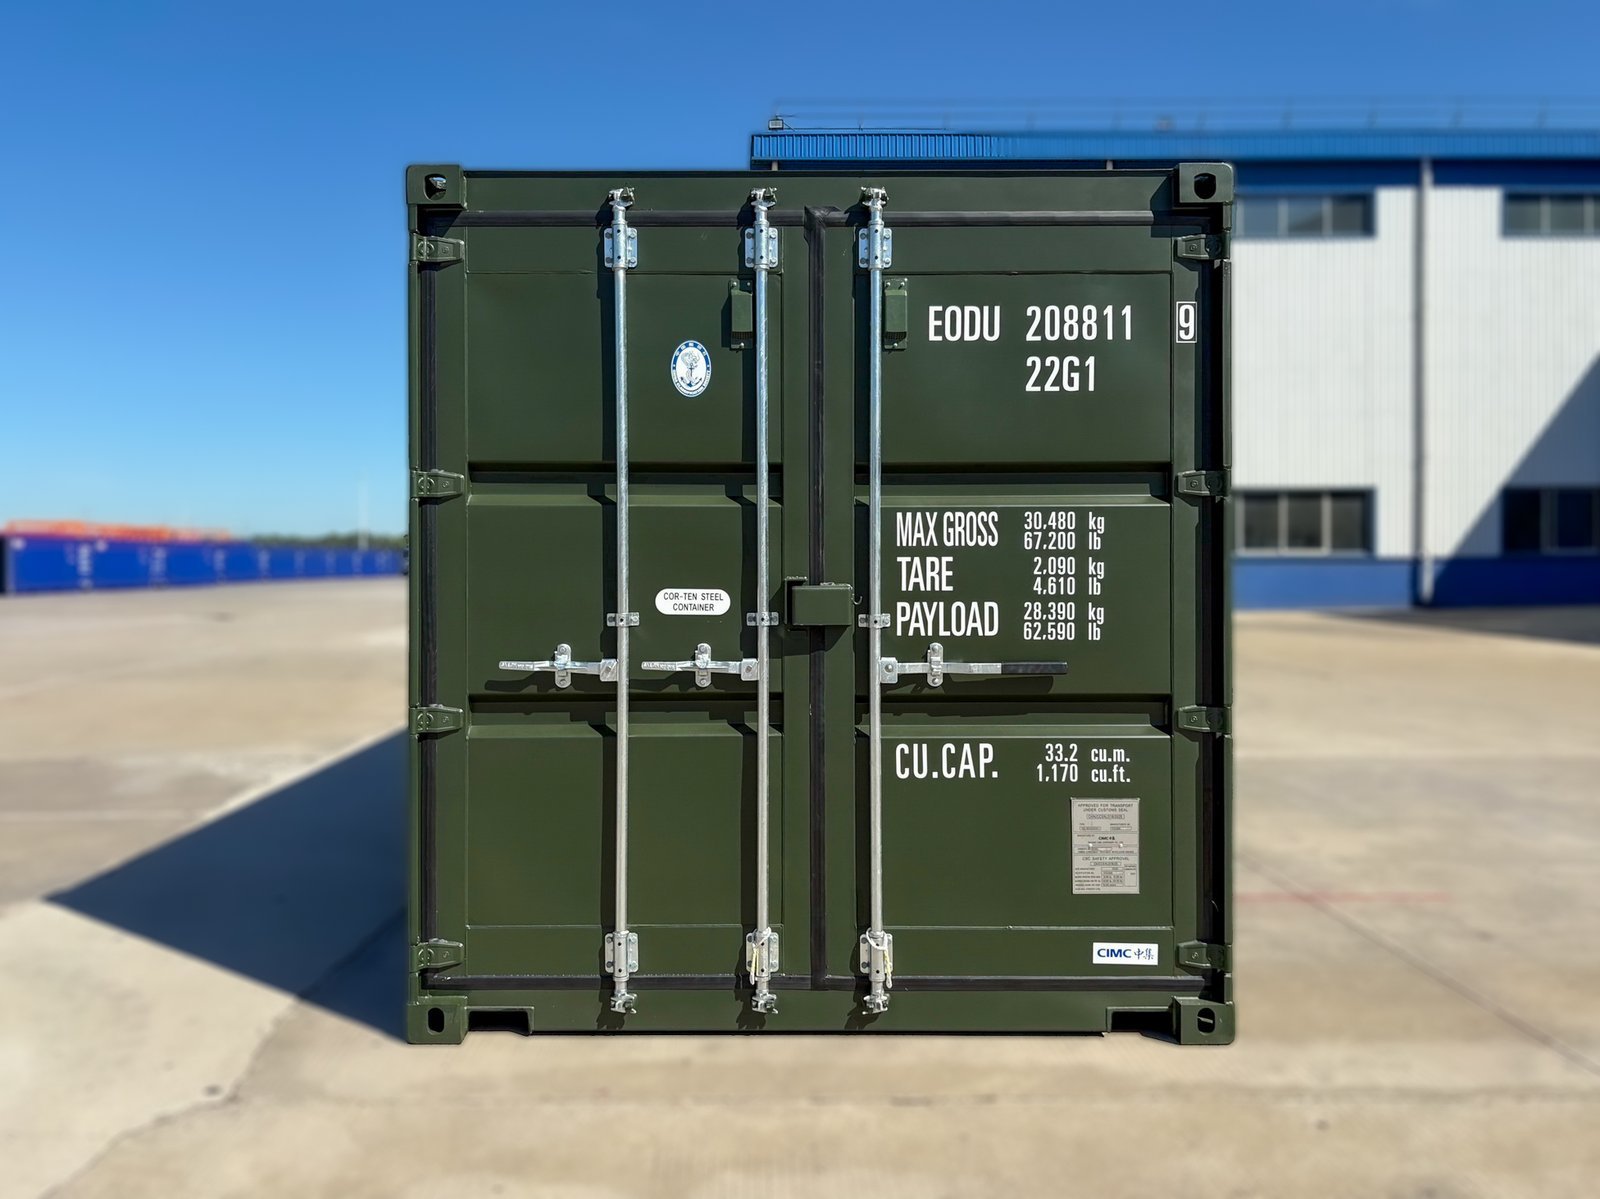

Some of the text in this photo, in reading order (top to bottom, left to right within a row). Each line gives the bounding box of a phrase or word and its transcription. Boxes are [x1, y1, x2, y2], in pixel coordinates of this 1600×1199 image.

[928, 304, 1195, 342] EODU 208811 9
[1025, 355, 1095, 392] 22G1
[896, 511, 1105, 547] MAX GROSS 30,480 kg
[1023, 531, 1104, 550] 67,200 lb
[896, 556, 1105, 592] TARE 2,090 kg
[1033, 576, 1104, 596] 4,610 lb
[663, 592, 724, 601] COR-TEN STEEL
[672, 602, 715, 612] CONTAINER
[896, 601, 1105, 637] PAYLOAD 28,390 kg
[1023, 621, 1104, 641] 62,590 lb
[895, 742, 1131, 780] CU.CAP. 33.2 cu.m.
[1036, 763, 1131, 783] 1,170 cu.ft.
[1097, 948, 1132, 959] CIMC
